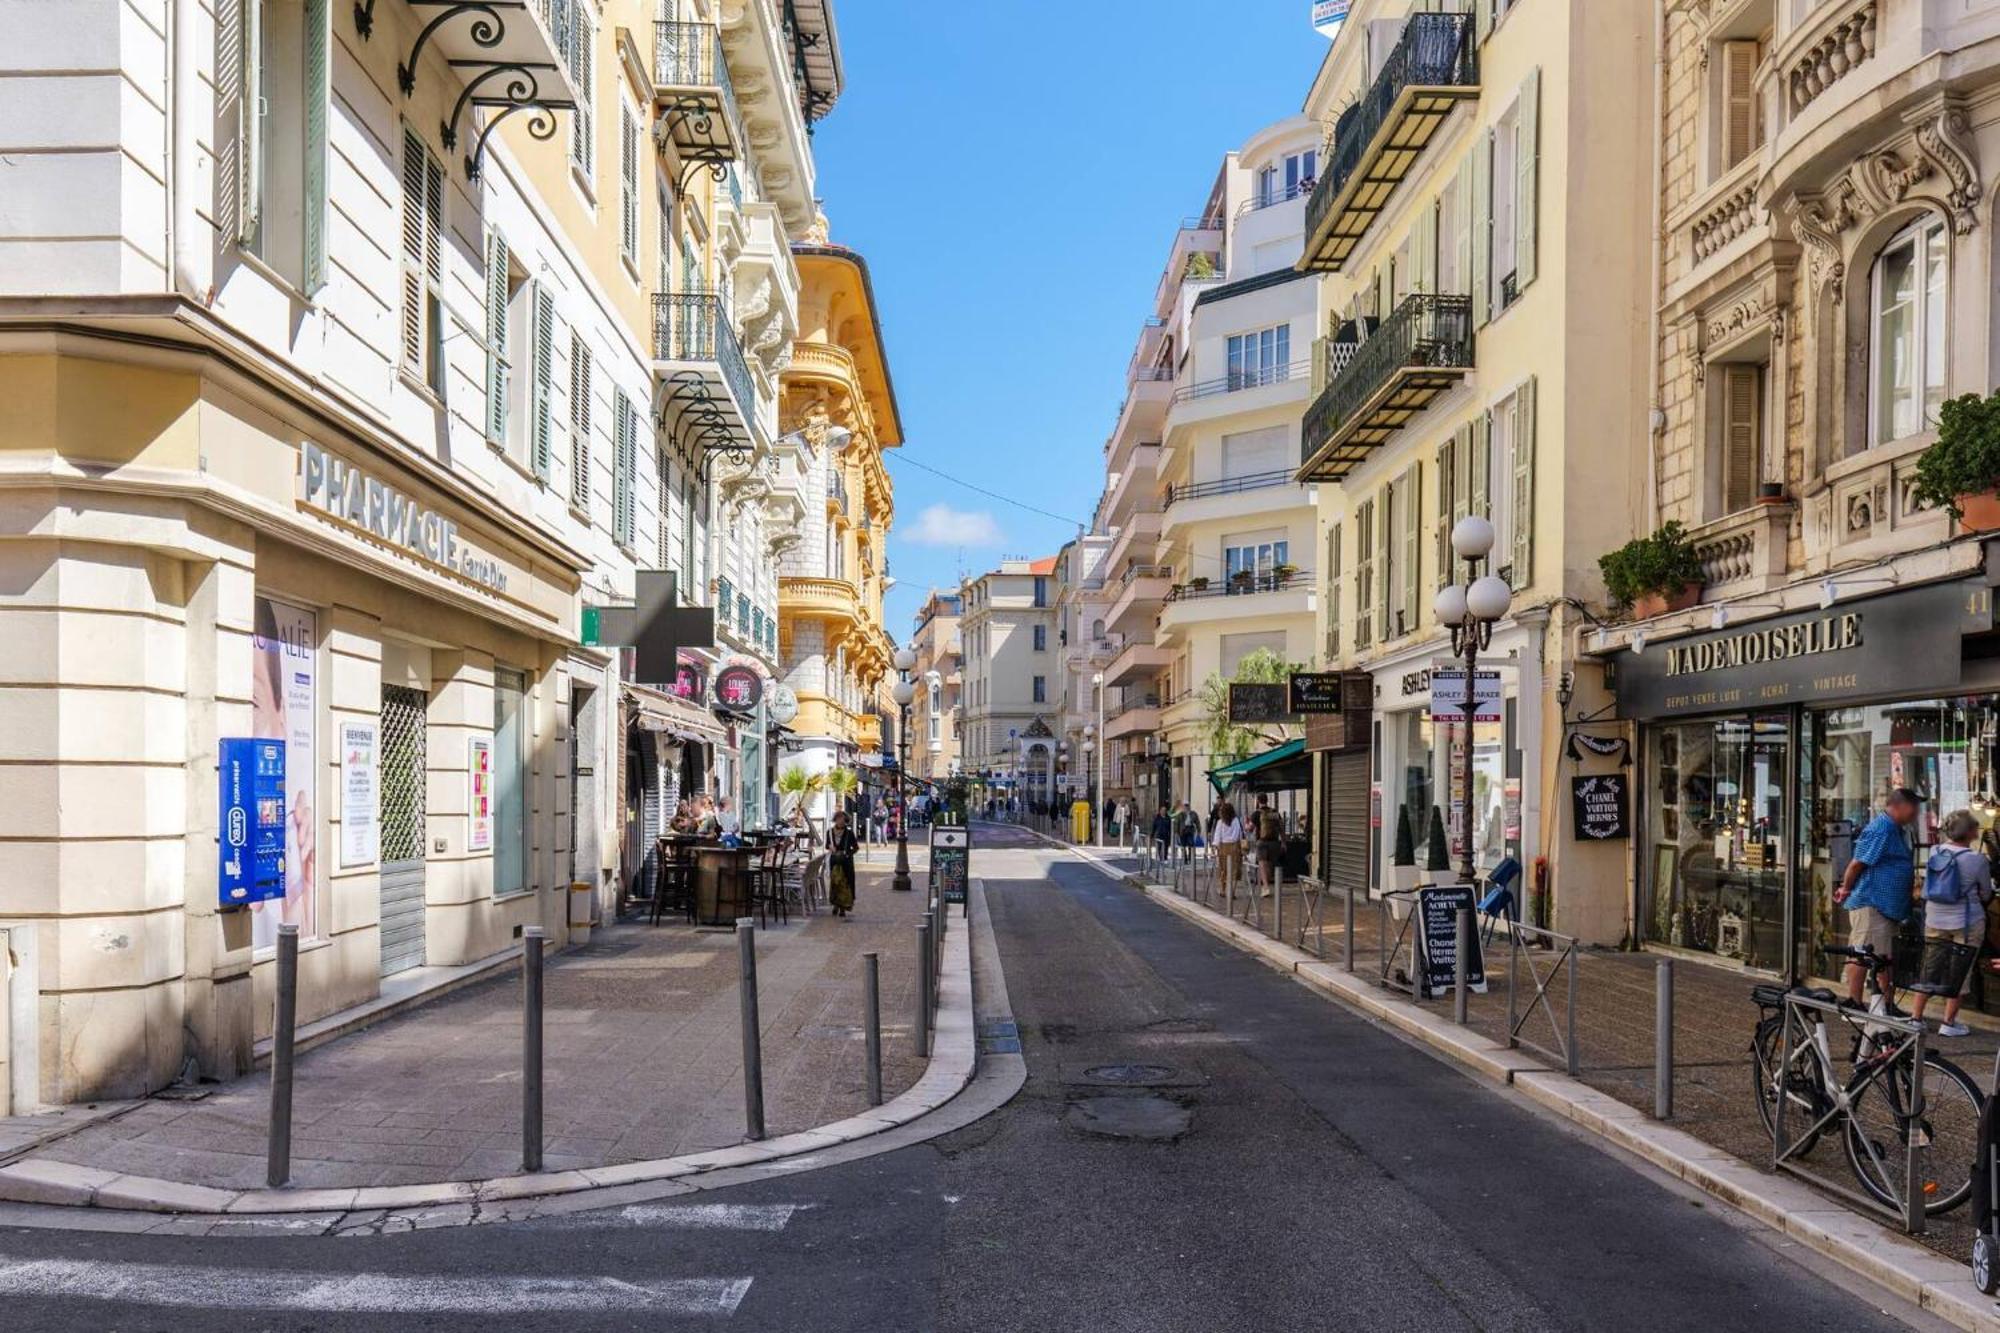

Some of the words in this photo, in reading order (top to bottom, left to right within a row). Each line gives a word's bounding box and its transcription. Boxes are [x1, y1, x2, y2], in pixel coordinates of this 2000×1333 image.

[301, 441, 458, 569] PHARMACIE
[1965, 591, 1987, 615] 41
[1666, 613, 1859, 676] MADEMOISELLE
[1401, 668, 1431, 696] ASHLEY
[1761, 684, 1790, 698] ACHAT
[1813, 674, 1857, 691] VINTAGE
[1585, 792, 1615, 803] CHANEL
[1586, 803, 1618, 813] VUITTON
[232, 811, 244, 843] durex
